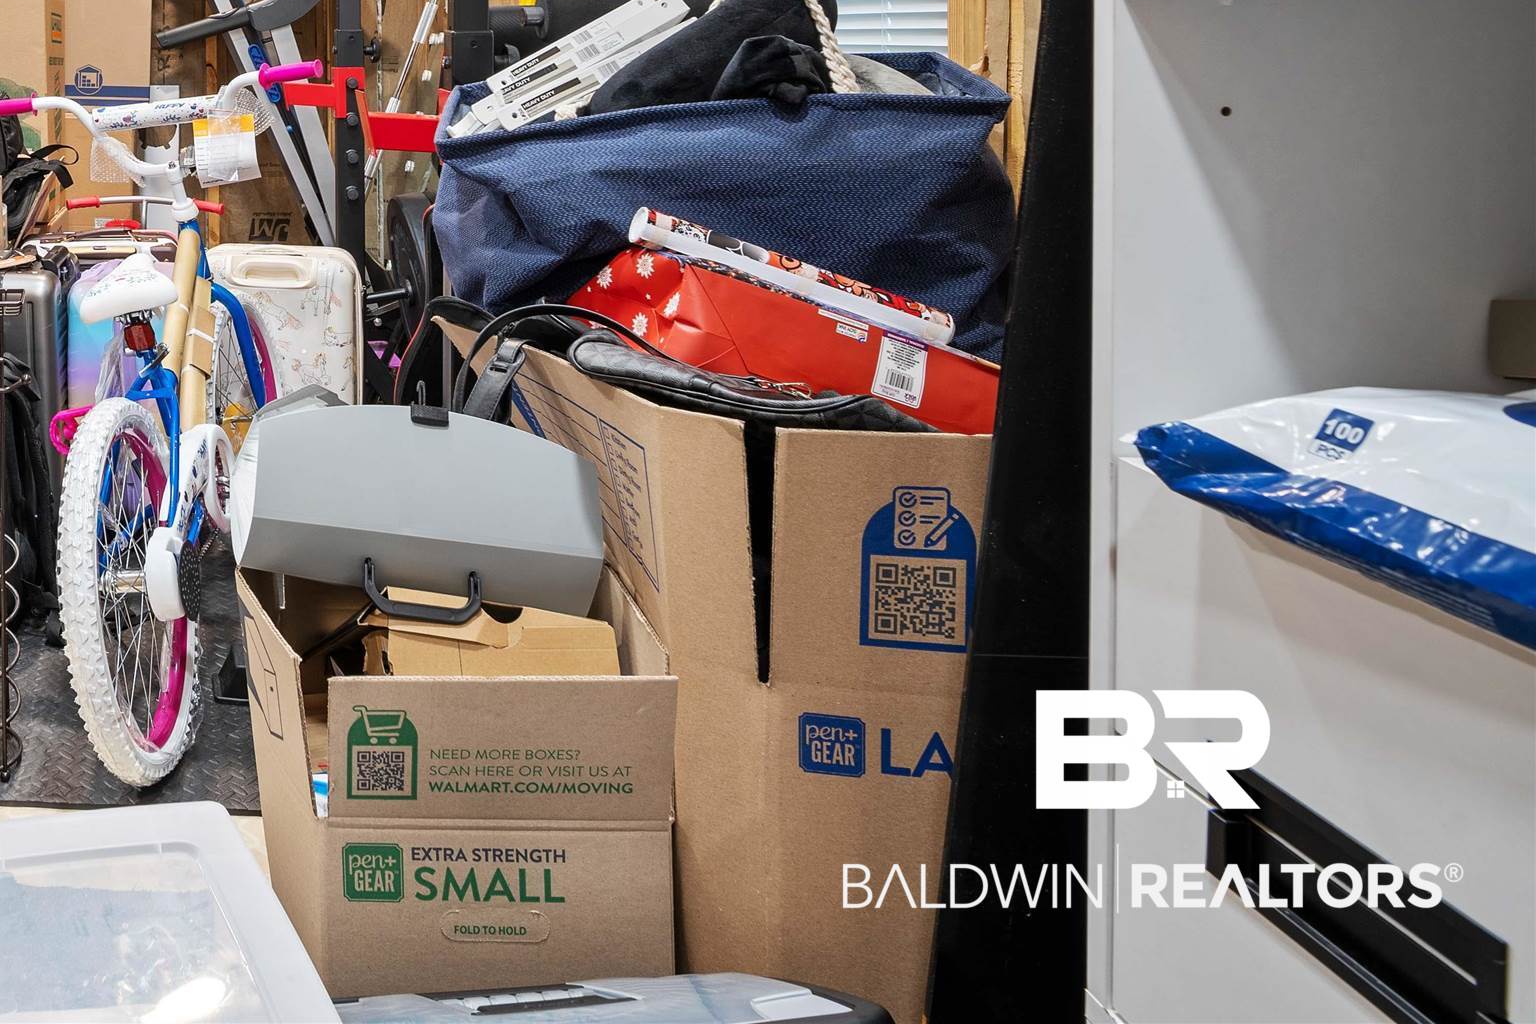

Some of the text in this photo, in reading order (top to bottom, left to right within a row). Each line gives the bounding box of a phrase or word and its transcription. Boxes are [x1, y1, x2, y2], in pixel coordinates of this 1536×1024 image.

[522, 90, 555, 109] HEAVY DUTY
[1324, 418, 1365, 445] 100
[805, 724, 858, 745] pen+
[430, 749, 581, 761] NEED MORE BOXES?
[811, 740, 856, 767] GEAR
[429, 765, 632, 777] SCAN HERE OR VISIT US AT
[428, 781, 633, 794] WALMART.COM/MOVING
[348, 852, 397, 877] pen+
[411, 847, 566, 863] EXTRA STRENGTH
[353, 871, 396, 893] GEAR
[414, 866, 566, 904] SMALL
[454, 925, 527, 936] FOLD TO HOLD
